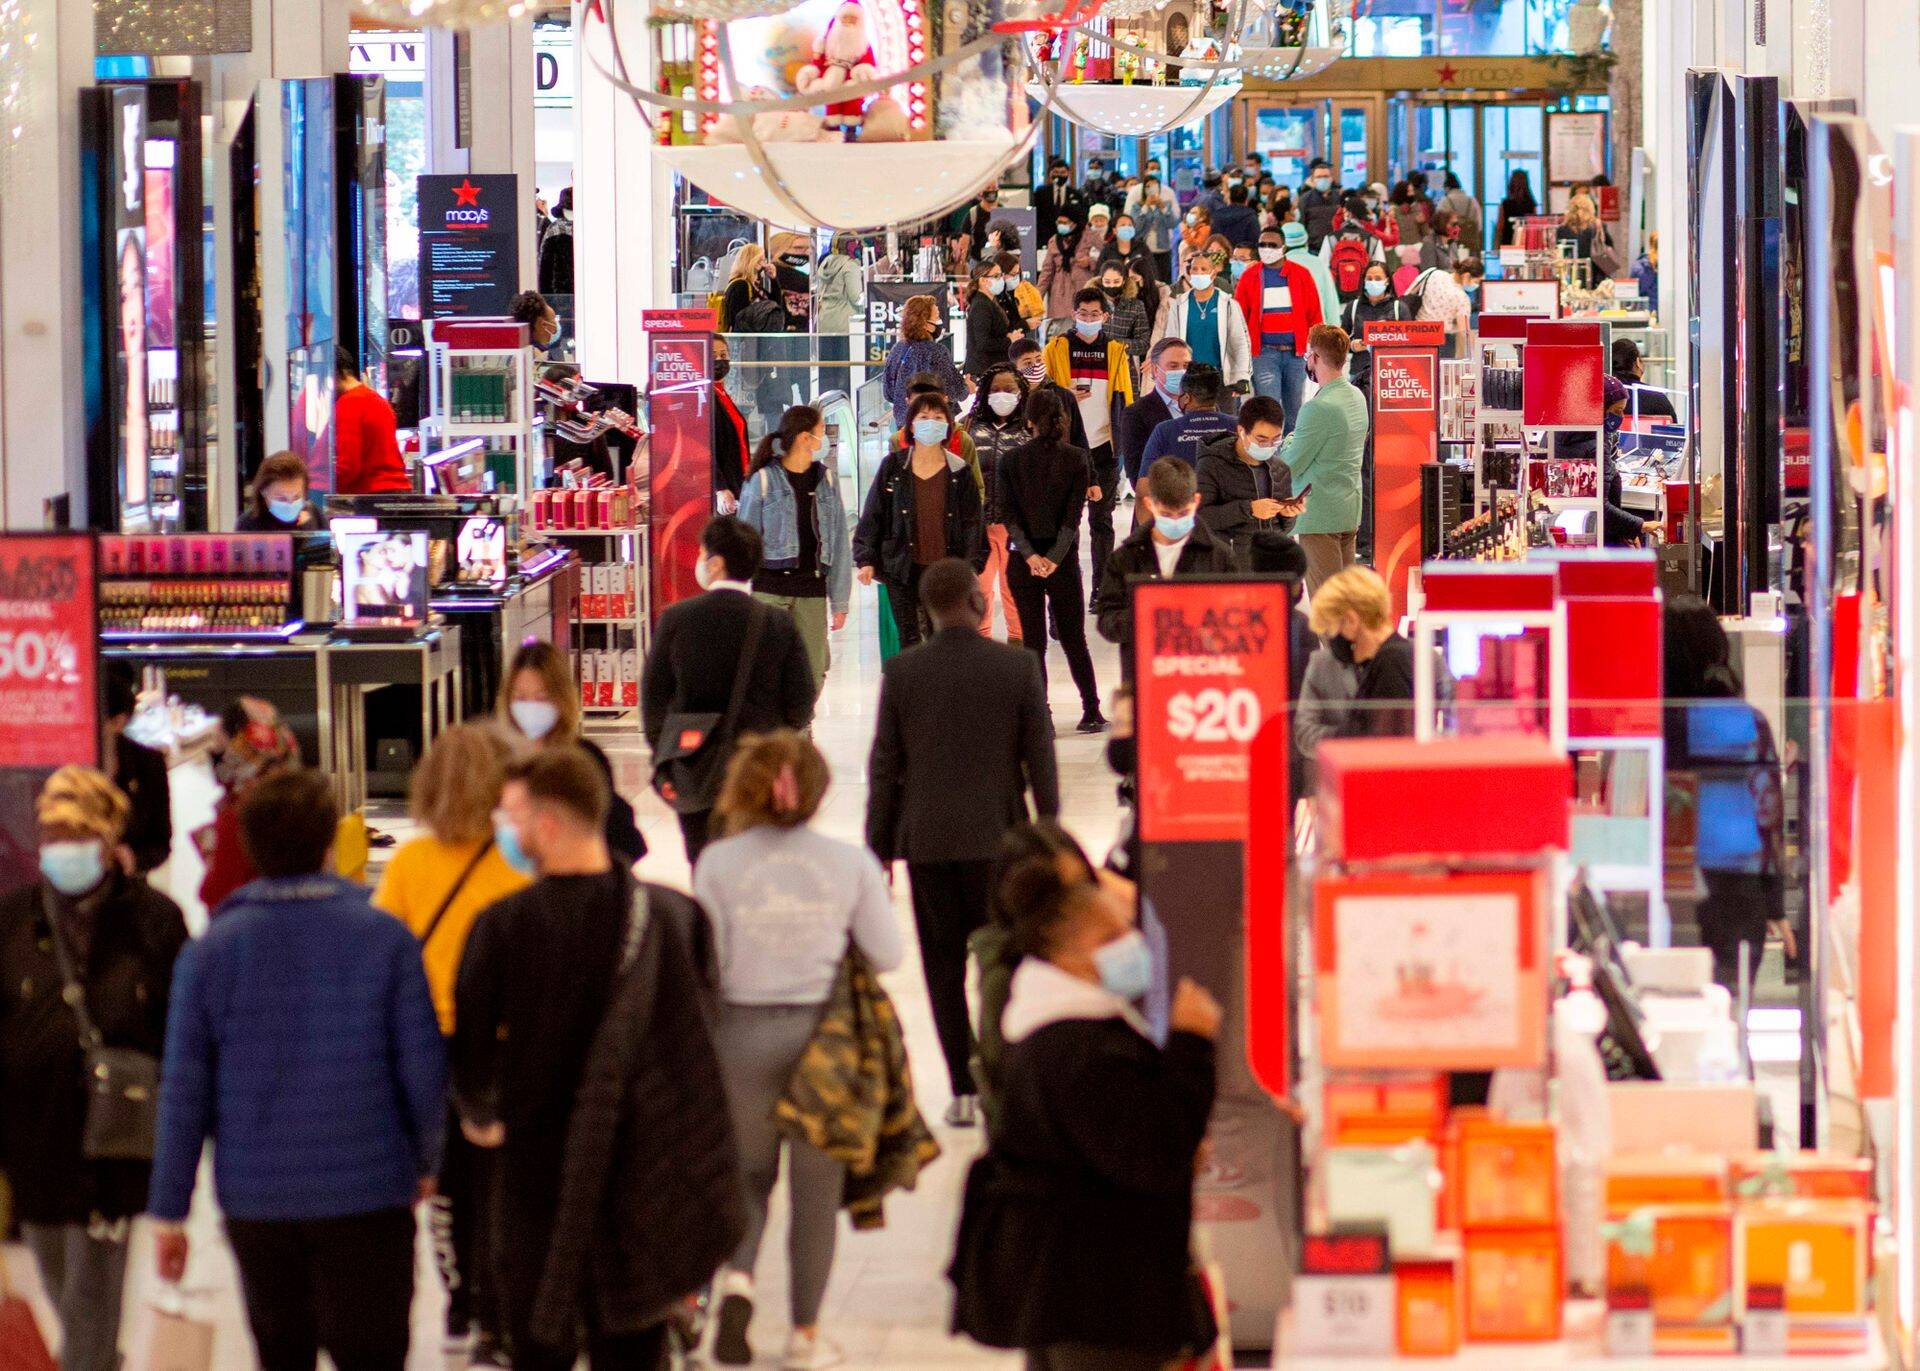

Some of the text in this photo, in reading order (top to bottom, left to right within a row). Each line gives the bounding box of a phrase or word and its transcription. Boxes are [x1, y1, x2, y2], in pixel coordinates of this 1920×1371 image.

[678, 312, 712, 320] FRIDAY
[644, 320, 684, 328] SPECIAL
[1368, 324, 1440, 333] BLACK FRIDAY
[1368, 333, 1409, 342] SPECIAL
[656, 352, 685, 362] GIVE.
[662, 362, 695, 372] LOVE.
[1380, 368, 1410, 379] GIVE.
[1388, 378, 1422, 389] LOVE.
[1380, 388, 1432, 399] BELIEVE.
[1153, 608, 1266, 632] BLACK
[1152, 656, 1244, 676] SPECIAL
[1167, 687, 1261, 742] $20
